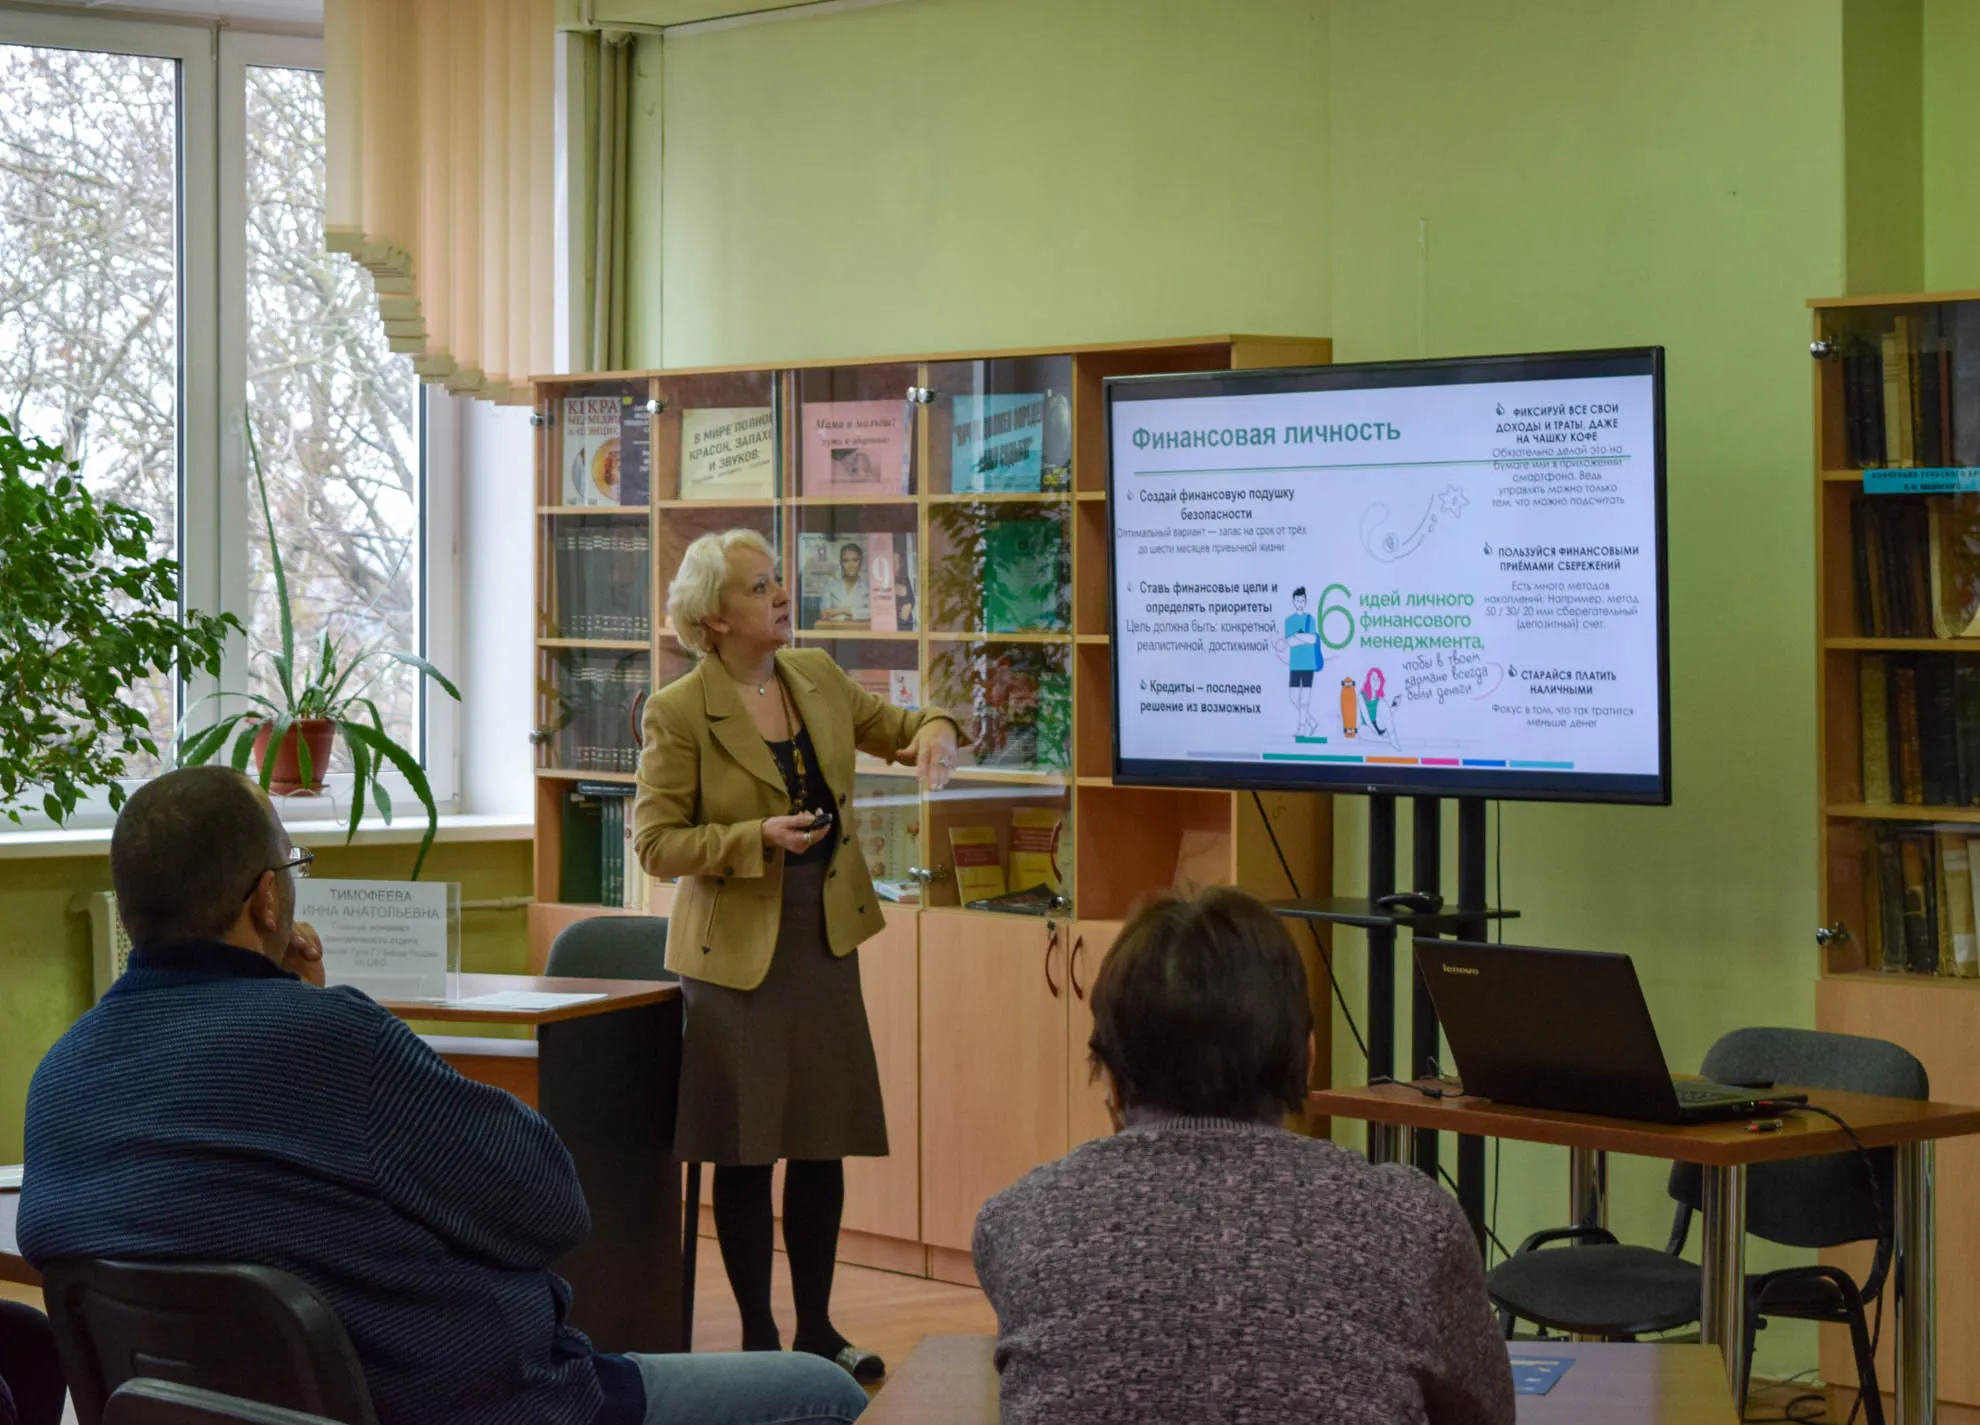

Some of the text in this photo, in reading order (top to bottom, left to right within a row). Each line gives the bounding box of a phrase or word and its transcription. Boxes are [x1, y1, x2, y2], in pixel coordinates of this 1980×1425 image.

[1513, 403, 1619, 417] ФИКСИРУЙ ВСЕ СВОИ
[1496, 421, 1541, 433] ДОХОДЫ
[1544, 421, 1551, 431] И
[1588, 418, 1619, 430] ДАЖЕ
[694, 432, 701, 444] В
[703, 423, 732, 442] МИРЕ
[1132, 420, 1401, 451] Финансовая личность
[1516, 431, 1598, 444] НА ЧАШКУ КОФЕ
[1492, 444, 1623, 458] Обязательно делай это на
[1579, 470, 1602, 481] Ведь
[1139, 487, 1295, 506] Создай финансовую подушку
[1498, 483, 1617, 496] управлять можно только
[1516, 498, 1530, 506] что
[1533, 497, 1567, 506] можно
[1570, 495, 1625, 507] подсчитать
[1180, 507, 1253, 521] безопасности
[1116, 526, 1171, 539] Оптимальный
[1173, 527, 1206, 539] вариант
[1218, 526, 1239, 538] запас
[1240, 526, 1253, 536] на
[1255, 526, 1275, 538] срок
[1276, 526, 1286, 536] от
[1138, 544, 1148, 555] до
[1149, 544, 1174, 554] шести
[1176, 543, 1210, 555] месяцев
[1212, 541, 1257, 554] привычной
[1498, 544, 1639, 558] ПОЛЬЗУЙСЯ ФИНАНСОВЫМИ
[1557, 558, 1621, 571] СБЕРЕЖЕНИЙ
[872, 556, 891, 590] 9
[1139, 580, 1278, 597] Ставь финансовые цели и
[1512, 580, 1610, 592] Есть много методов
[1359, 591, 1475, 609] идей личного
[1607, 595, 1640, 605] метод
[1146, 602, 1272, 615] определять приоритеты
[1485, 606, 1496, 617] 50
[1523, 605, 1534, 617] 20
[1536, 608, 1553, 616] или
[1556, 605, 1638, 617] сберегательный
[1317, 583, 1355, 650] 6
[1359, 611, 1472, 631] финансового
[1126, 619, 1151, 635] Цель
[1152, 619, 1190, 635] должна
[1221, 619, 1280, 635] конкретной,
[1517, 618, 1579, 631] (депозитный)
[1137, 638, 1269, 654] реалистичной, достижимой
[1359, 635, 1485, 652] менеджмента,
[1402, 654, 1433, 672] чтобы
[1436, 652, 1445, 668] в
[1404, 664, 1489, 692] кармане всегда
[1521, 668, 1617, 681] СТАРАЙСЯ ПЛАТИТЬ
[1150, 680, 1195, 694] Кредиты
[1206, 682, 1262, 695] последнее
[1407, 683, 1473, 705] были деньги
[1530, 684, 1593, 696] НАЛИЧНЫМИ
[1140, 701, 1262, 714] решение из возможных
[1491, 703, 1522, 716] Фокус
[1556, 705, 1570, 714] что
[1573, 706, 1588, 715] так
[1591, 706, 1634, 716] тратится
[1526, 718, 1597, 729] меньше денег
[329, 888, 413, 903] ТИМОФЕЕВА
[302, 903, 440, 920] ИННА АНАТОЛЬЕВНА
[1442, 963, 1479, 976] lenovo
